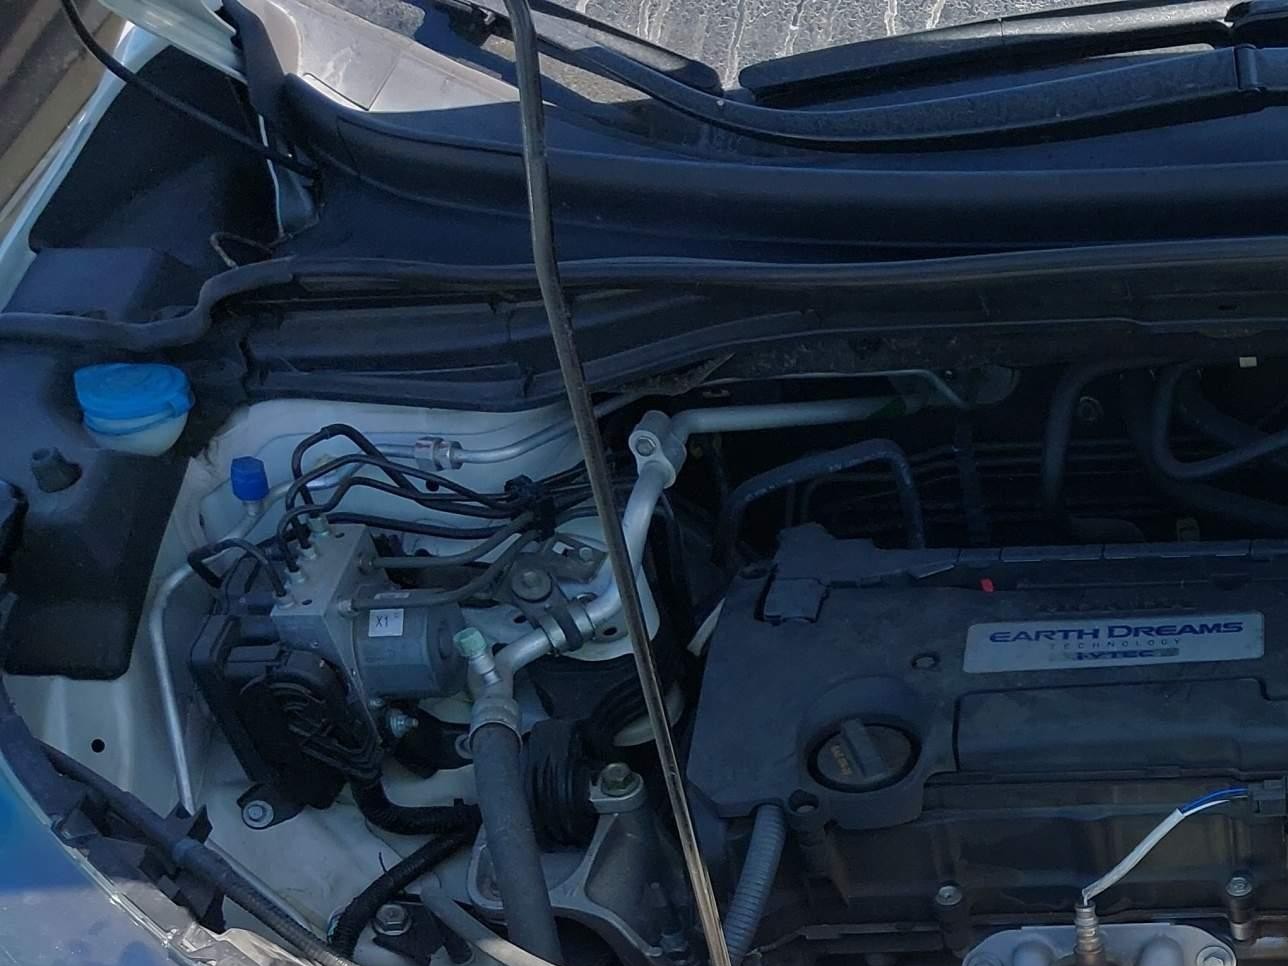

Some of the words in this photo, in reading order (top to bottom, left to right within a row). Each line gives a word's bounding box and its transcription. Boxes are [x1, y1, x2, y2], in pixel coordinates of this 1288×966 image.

[375, 615, 389, 628] X1
[989, 628, 1100, 642] EARTH
[1107, 622, 1244, 638] DREAMS
[1049, 639, 1180, 650] TECHNOLOGY
